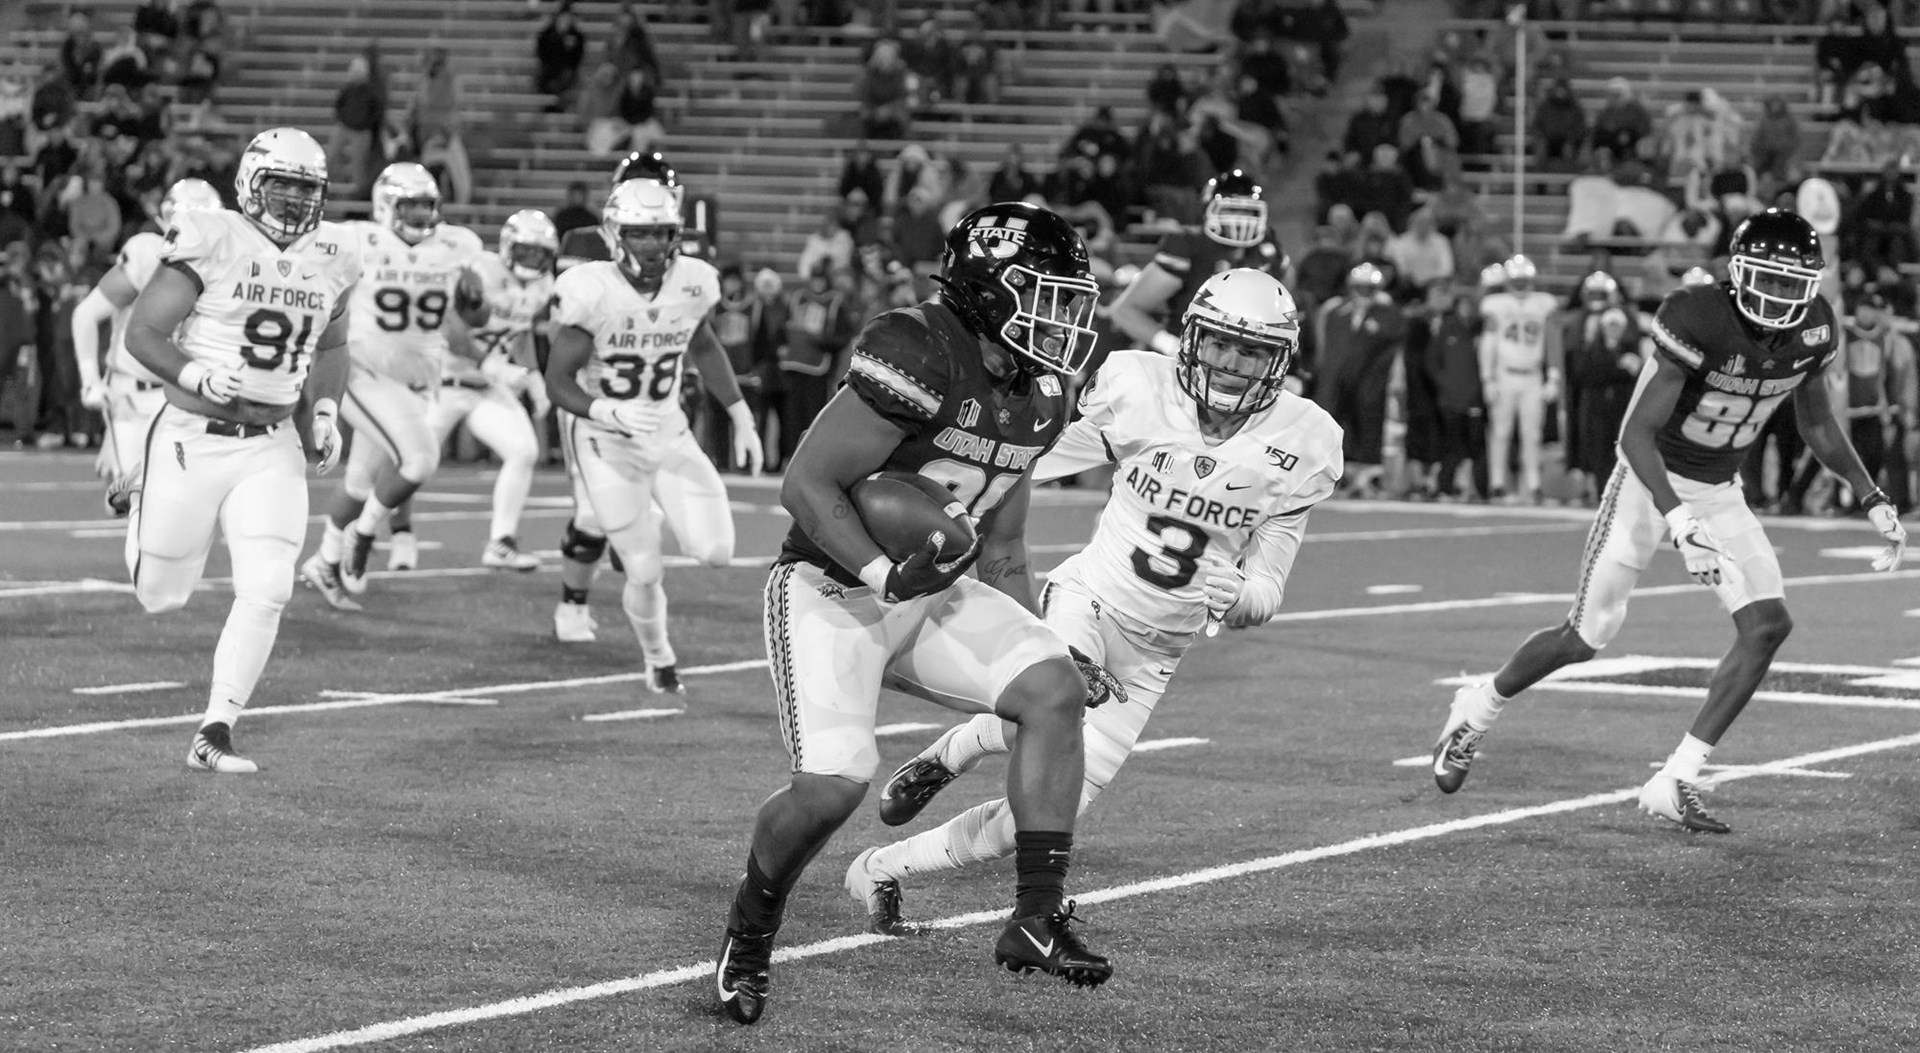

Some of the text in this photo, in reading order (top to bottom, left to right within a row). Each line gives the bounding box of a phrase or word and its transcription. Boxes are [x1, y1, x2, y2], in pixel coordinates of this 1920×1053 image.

[968, 227, 1027, 247] STATE
[232, 282, 325, 310] AIR FORCE
[375, 288, 448, 332] 99
[240, 308, 314, 374] 91
[608, 332, 637, 348] AIR
[599, 352, 683, 401] 38
[933, 426, 996, 464] UTAH
[1265, 446, 1299, 471] 150
[1126, 466, 1260, 529] AIR FORCE
[1130, 514, 1211, 590] 3
